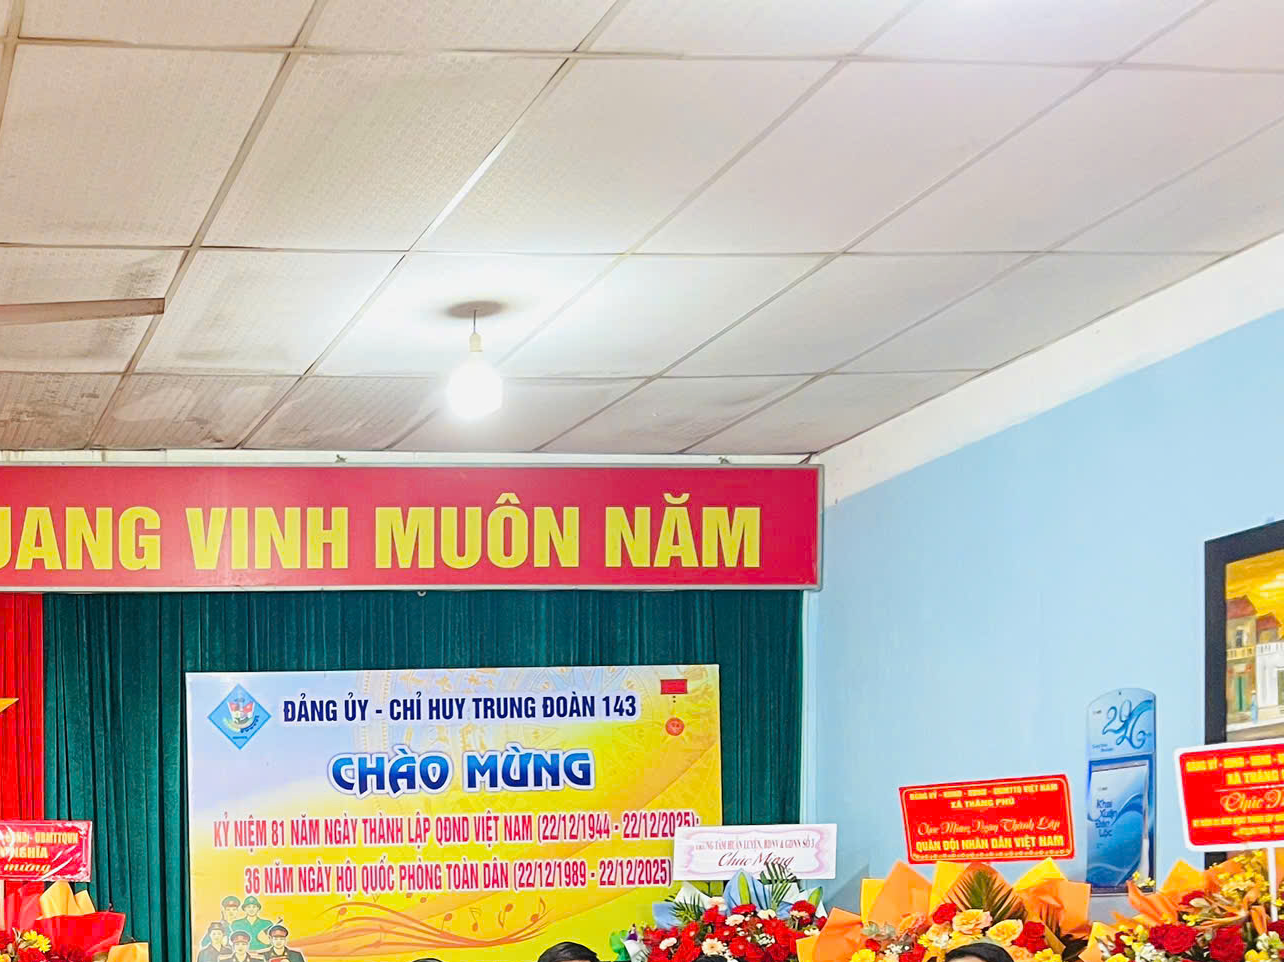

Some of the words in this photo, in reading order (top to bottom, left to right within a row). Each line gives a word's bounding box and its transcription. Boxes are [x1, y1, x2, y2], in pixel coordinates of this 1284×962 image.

[185, 506, 349, 571] VINH
[375, 492, 580, 569] MUÔN
[605, 492, 762, 568] NĂM
[283, 693, 337, 722] ĐẢNG
[344, 693, 369, 721] ỦY
[389, 691, 422, 720] CHỈ
[428, 698, 466, 720] HUY
[472, 697, 536, 719] TRUNG
[542, 692, 595, 718] ĐOÀN
[602, 695, 637, 717] 143
[332, 747, 450, 796] CHÀO
[467, 745, 591, 789] MỪNG
[214, 811, 230, 847] KỶ
[234, 814, 267, 852] NIỆM
[271, 820, 285, 846] 81
[291, 813, 320, 845] NĂM
[324, 812, 358, 845] NGÀY
[362, 812, 403, 844] THÀNH
[408, 811, 431, 849] LẬP
[435, 815, 469, 845] QĐND
[474, 810, 499, 848] VIỆT
[504, 815, 533, 841] NAM
[537, 813, 610, 843] (22/12/1944
[916, 840, 941, 852] QUÂN
[245, 867, 260, 894] 36
[265, 861, 294, 893] NĂM
[298, 860, 332, 892] NGÀY
[336, 859, 357, 897] HỘI
[361, 855, 394, 894] QUỐC
[399, 857, 442, 891] PHÒNG
[446, 857, 478, 889] TOÀN
[483, 857, 509, 888] DÂN
[514, 861, 586, 890] (22/12/1989
[599, 859, 672, 887] 22/12/2025)
